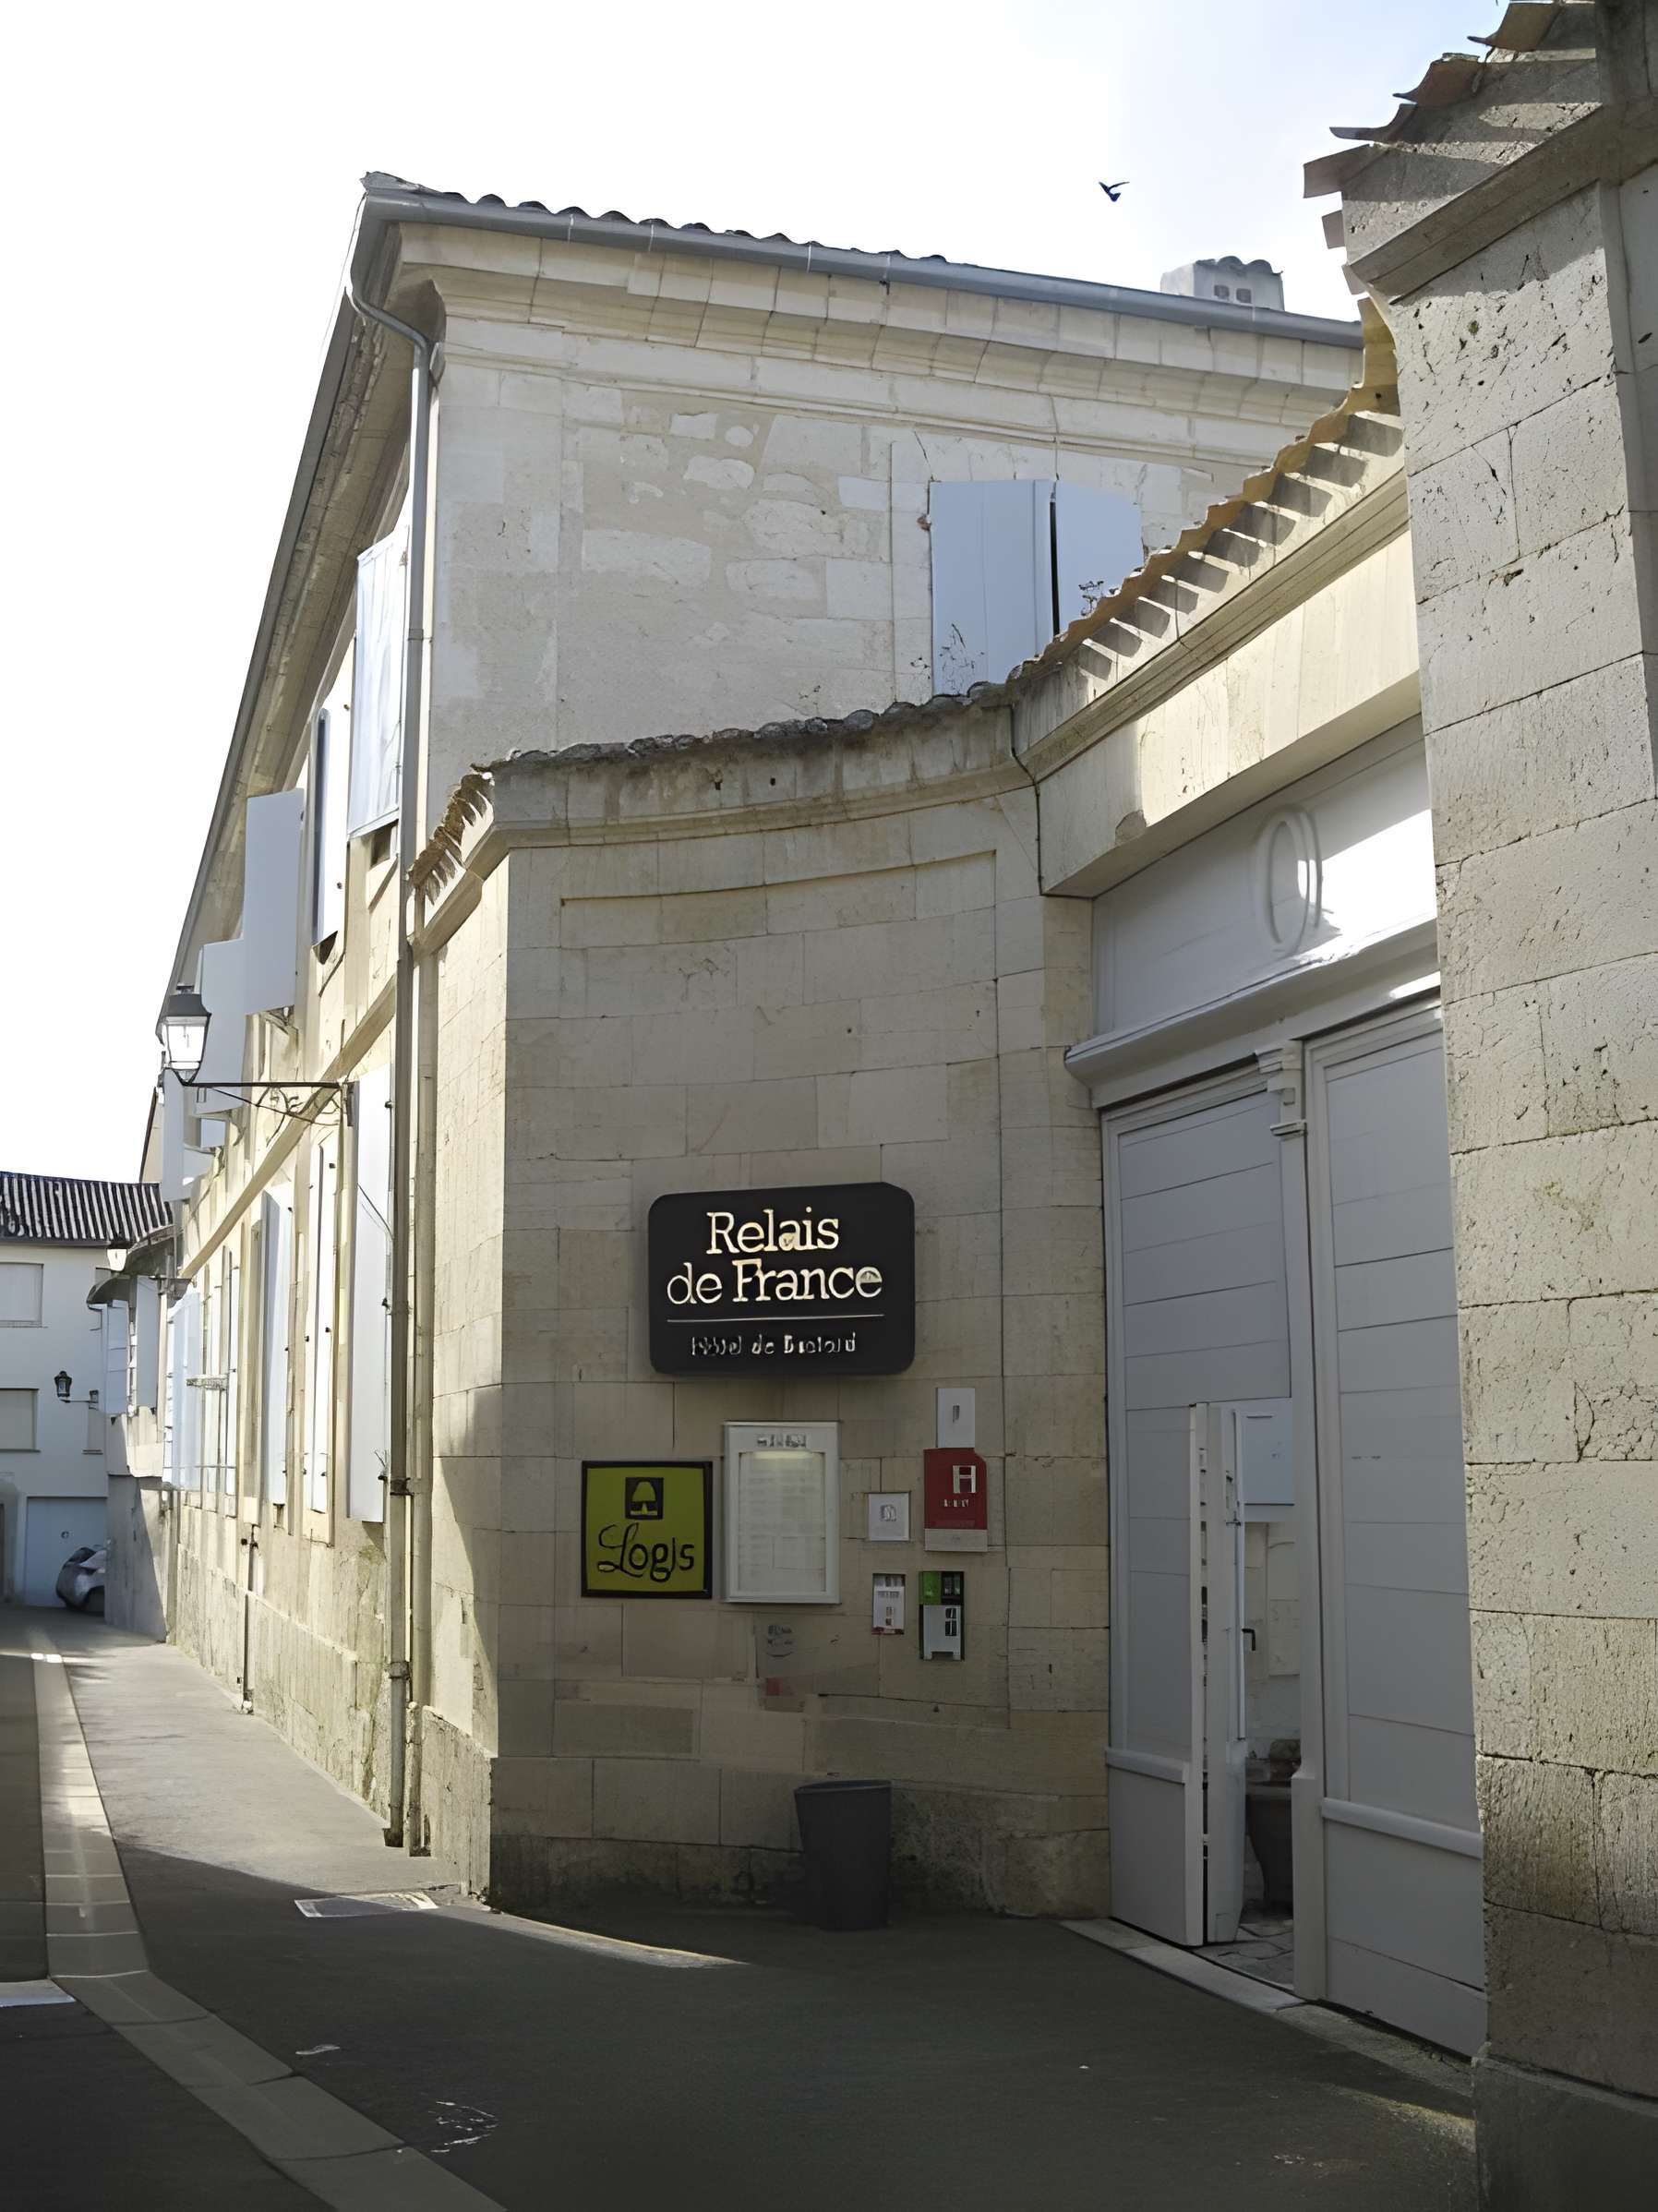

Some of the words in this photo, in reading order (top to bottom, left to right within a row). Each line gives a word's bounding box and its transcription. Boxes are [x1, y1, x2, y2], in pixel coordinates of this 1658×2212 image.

[706, 1207, 839, 1254] Relais
[667, 1262, 723, 1304] de
[732, 1258, 883, 1302] France
[597, 1522, 694, 1582] Logis
